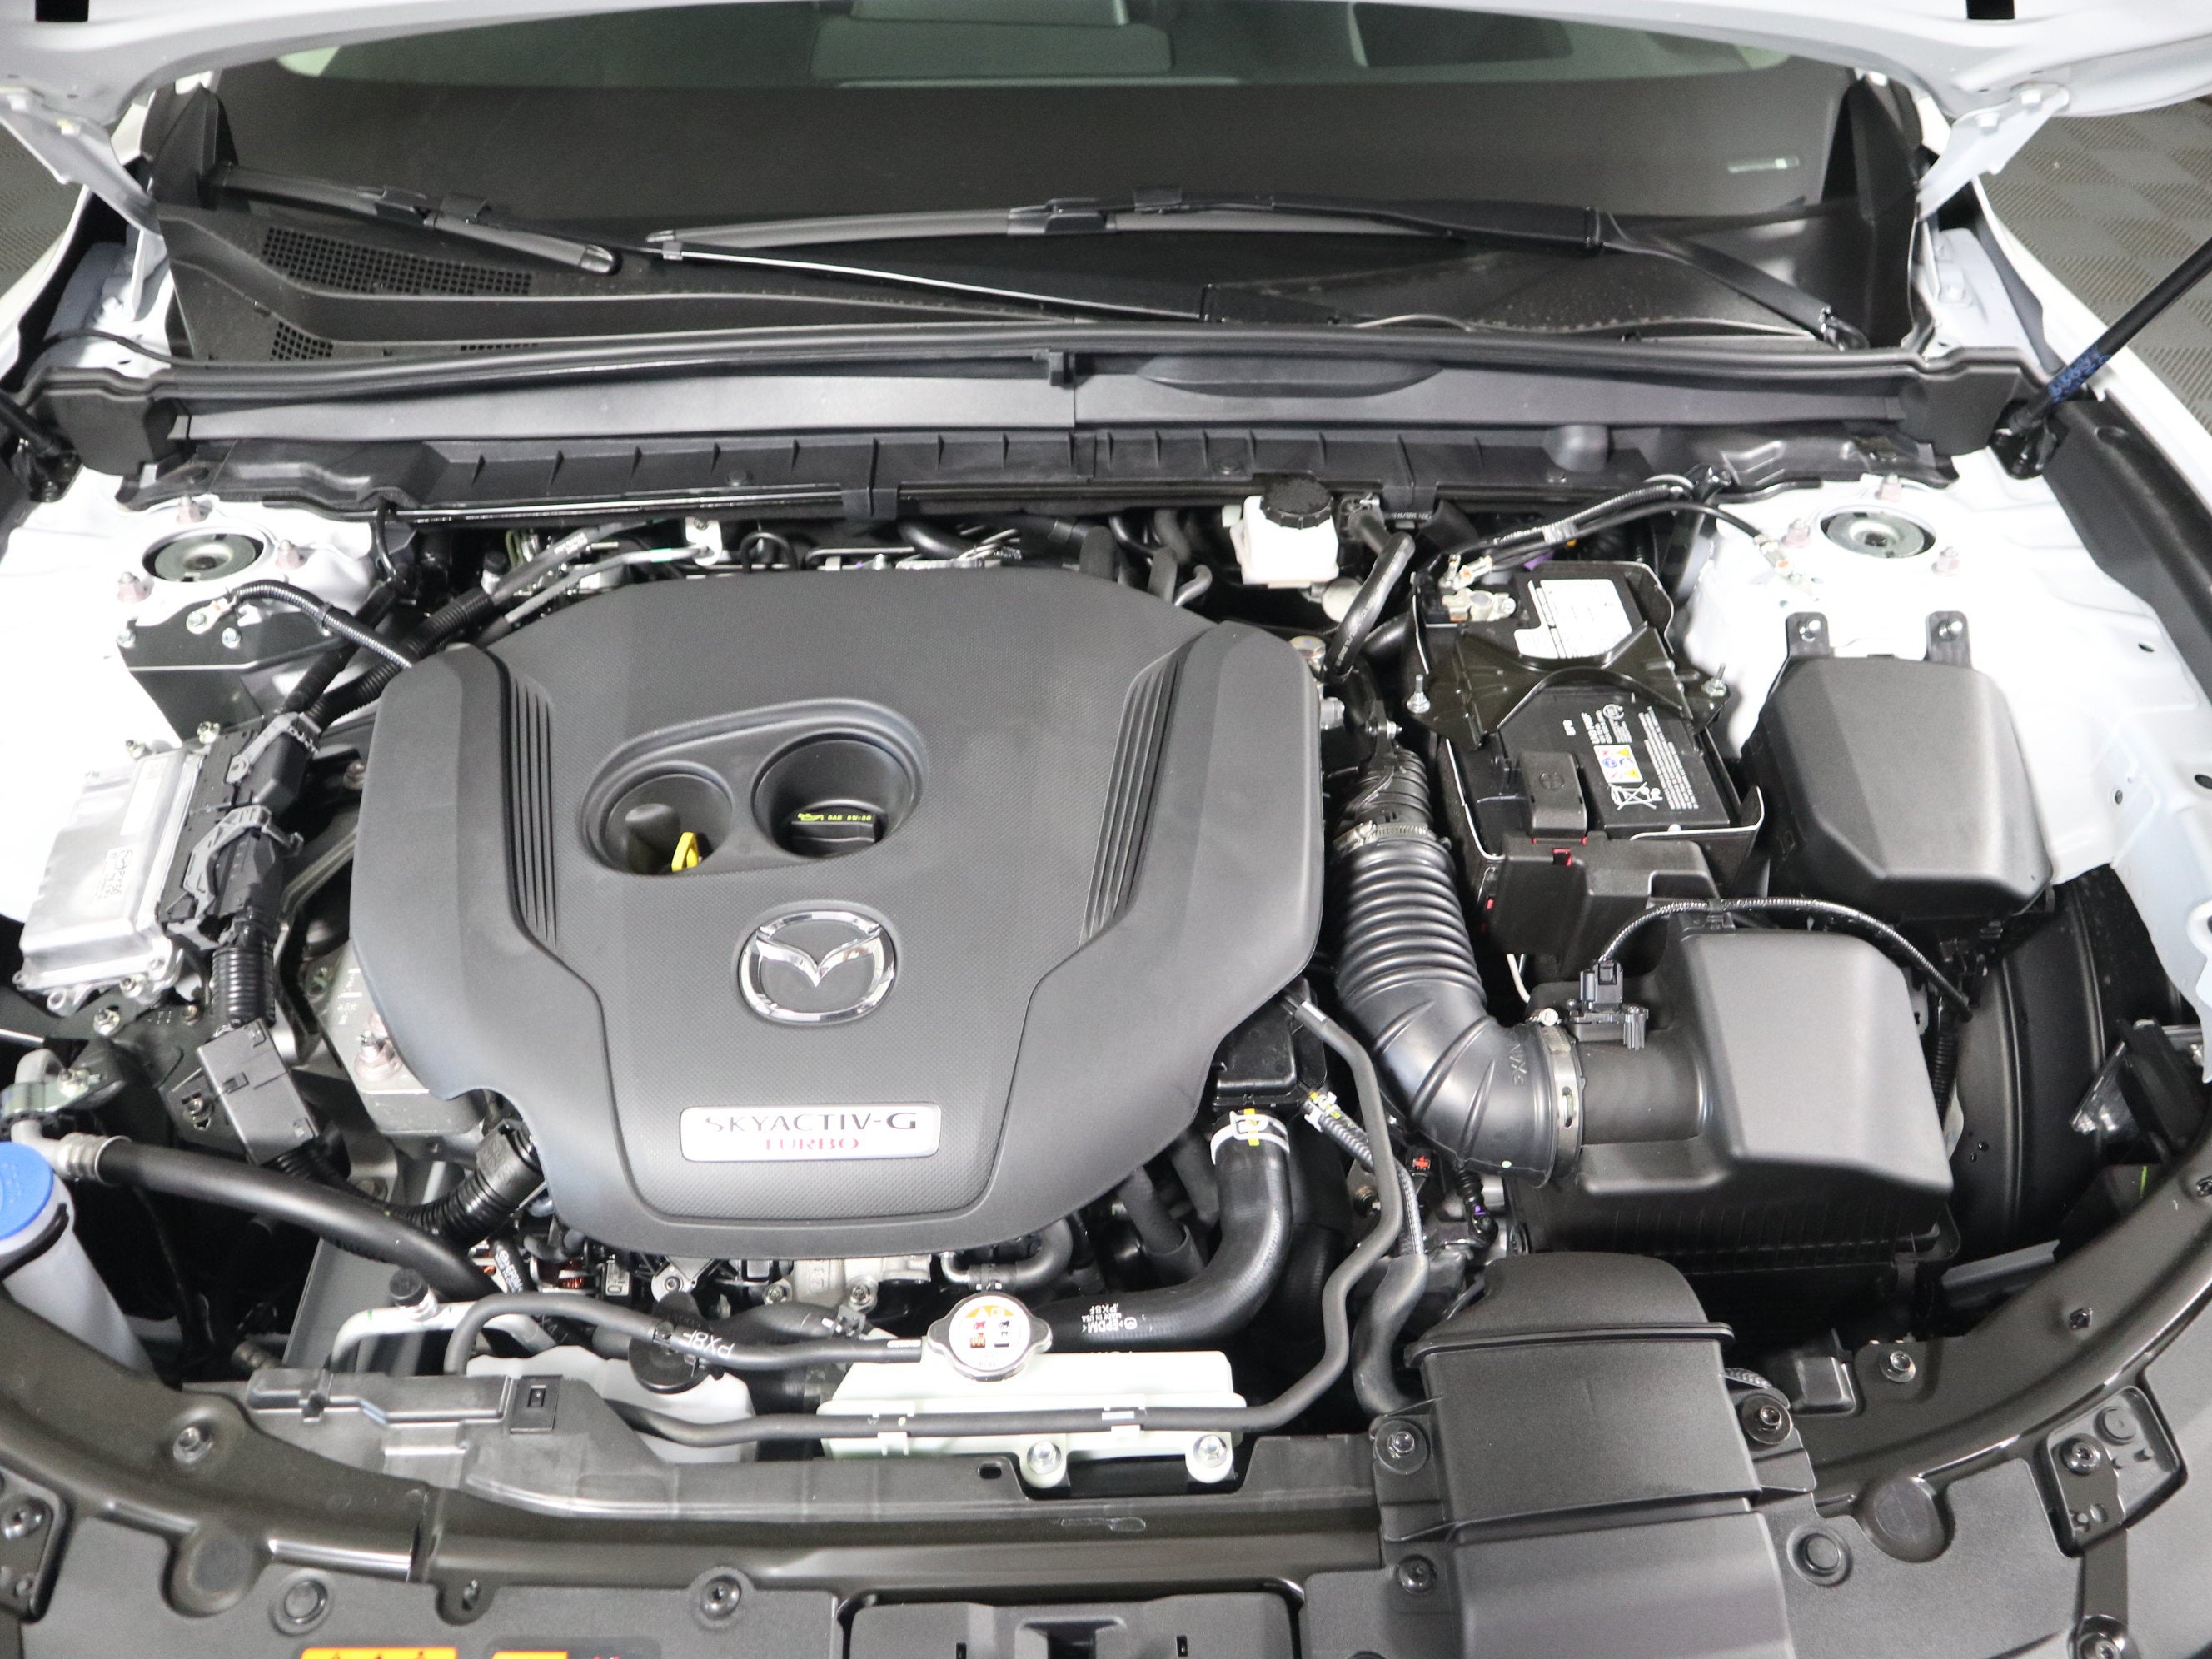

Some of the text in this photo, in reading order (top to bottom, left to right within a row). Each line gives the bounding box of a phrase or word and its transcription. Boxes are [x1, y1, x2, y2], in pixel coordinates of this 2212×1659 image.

[705, 1112, 917, 1133] SKYACTIV-G
[765, 1137, 859, 1150] TURBO
[1082, 1315, 1094, 1323] USA
[1095, 1313, 1103, 1323] IN
[679, 1330, 735, 1359] PX8F
